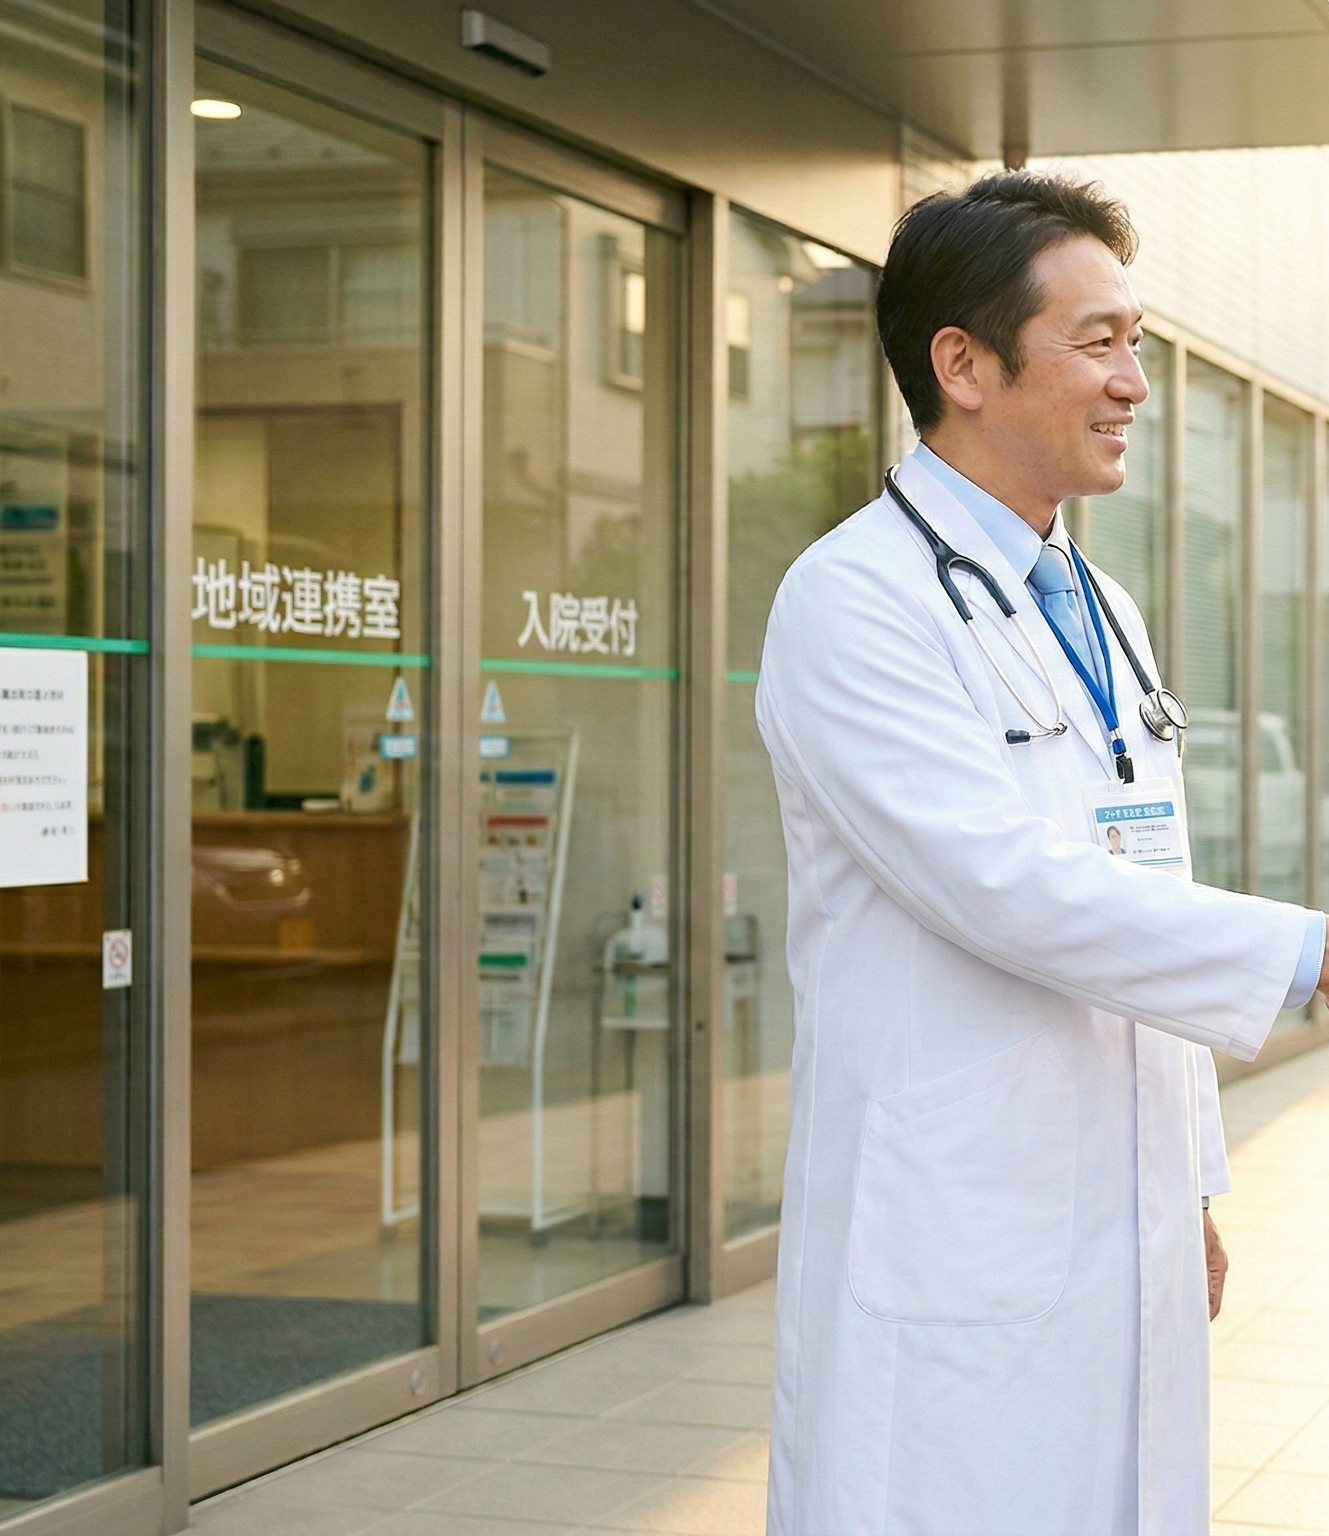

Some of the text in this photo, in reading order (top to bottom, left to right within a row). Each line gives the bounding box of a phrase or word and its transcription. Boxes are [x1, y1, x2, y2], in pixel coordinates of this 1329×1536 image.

[191, 556, 401, 639] 地域連携室
[517, 589, 639, 657] 入院受付
